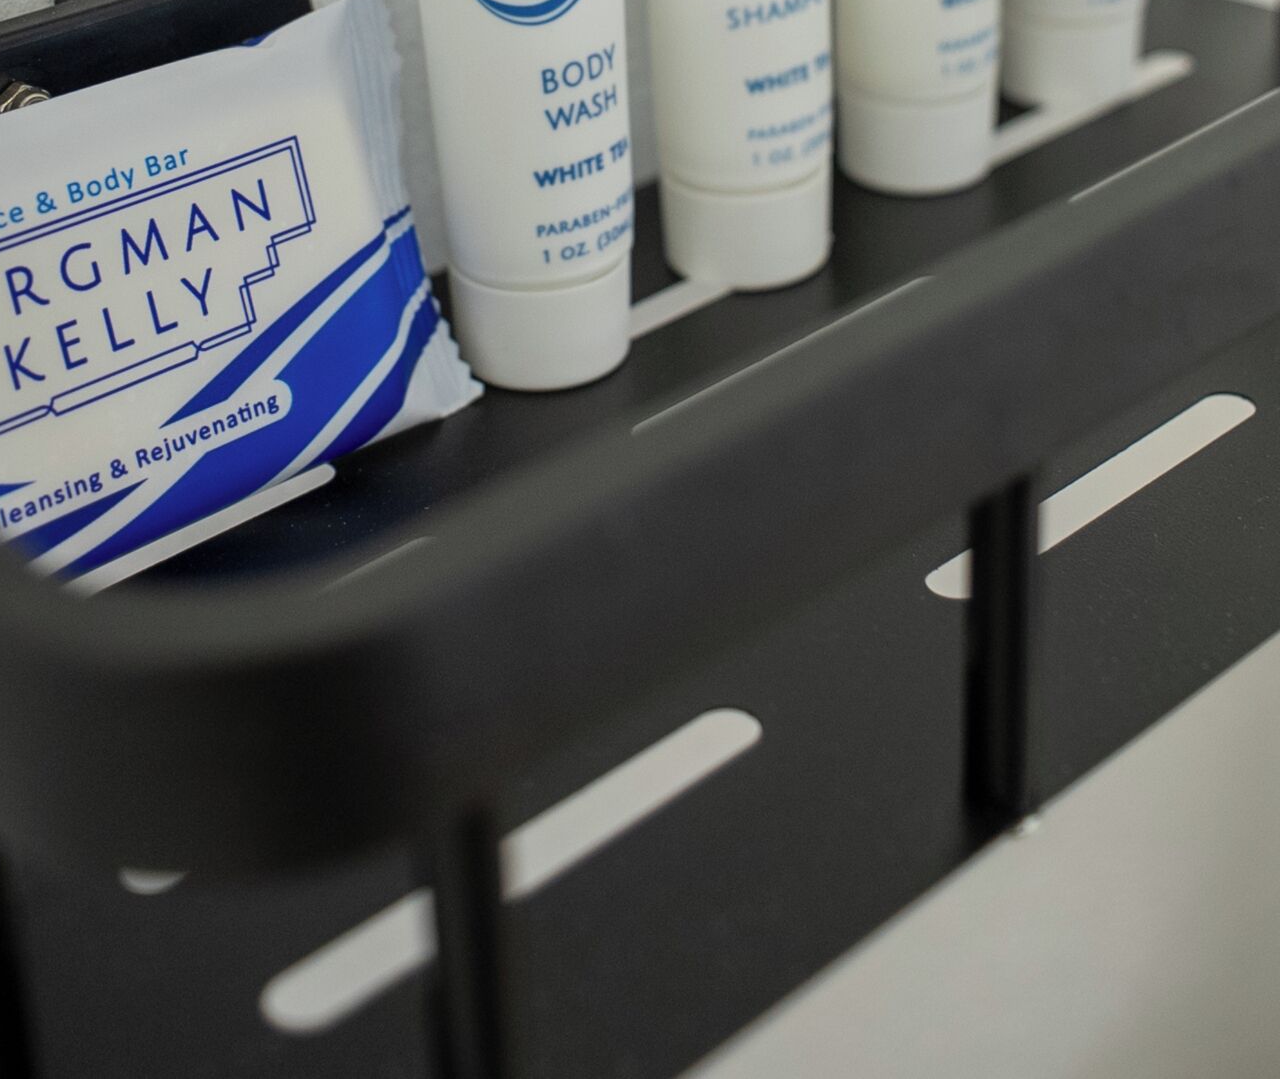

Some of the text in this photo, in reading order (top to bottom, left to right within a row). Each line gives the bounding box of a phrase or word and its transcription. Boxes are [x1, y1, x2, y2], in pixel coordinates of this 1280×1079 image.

[540, 42, 617, 96] BODY
[543, 84, 618, 132] WASH
[35, 190, 58, 215] &
[66, 166, 135, 204] Body
[144, 147, 189, 177] Bar
[532, 151, 605, 189] WHITE
[542, 248, 551, 264] 1
[3, 266, 216, 391] KELLY
[109, 457, 129, 480] &
[134, 392, 280, 469] Rejuvenating
